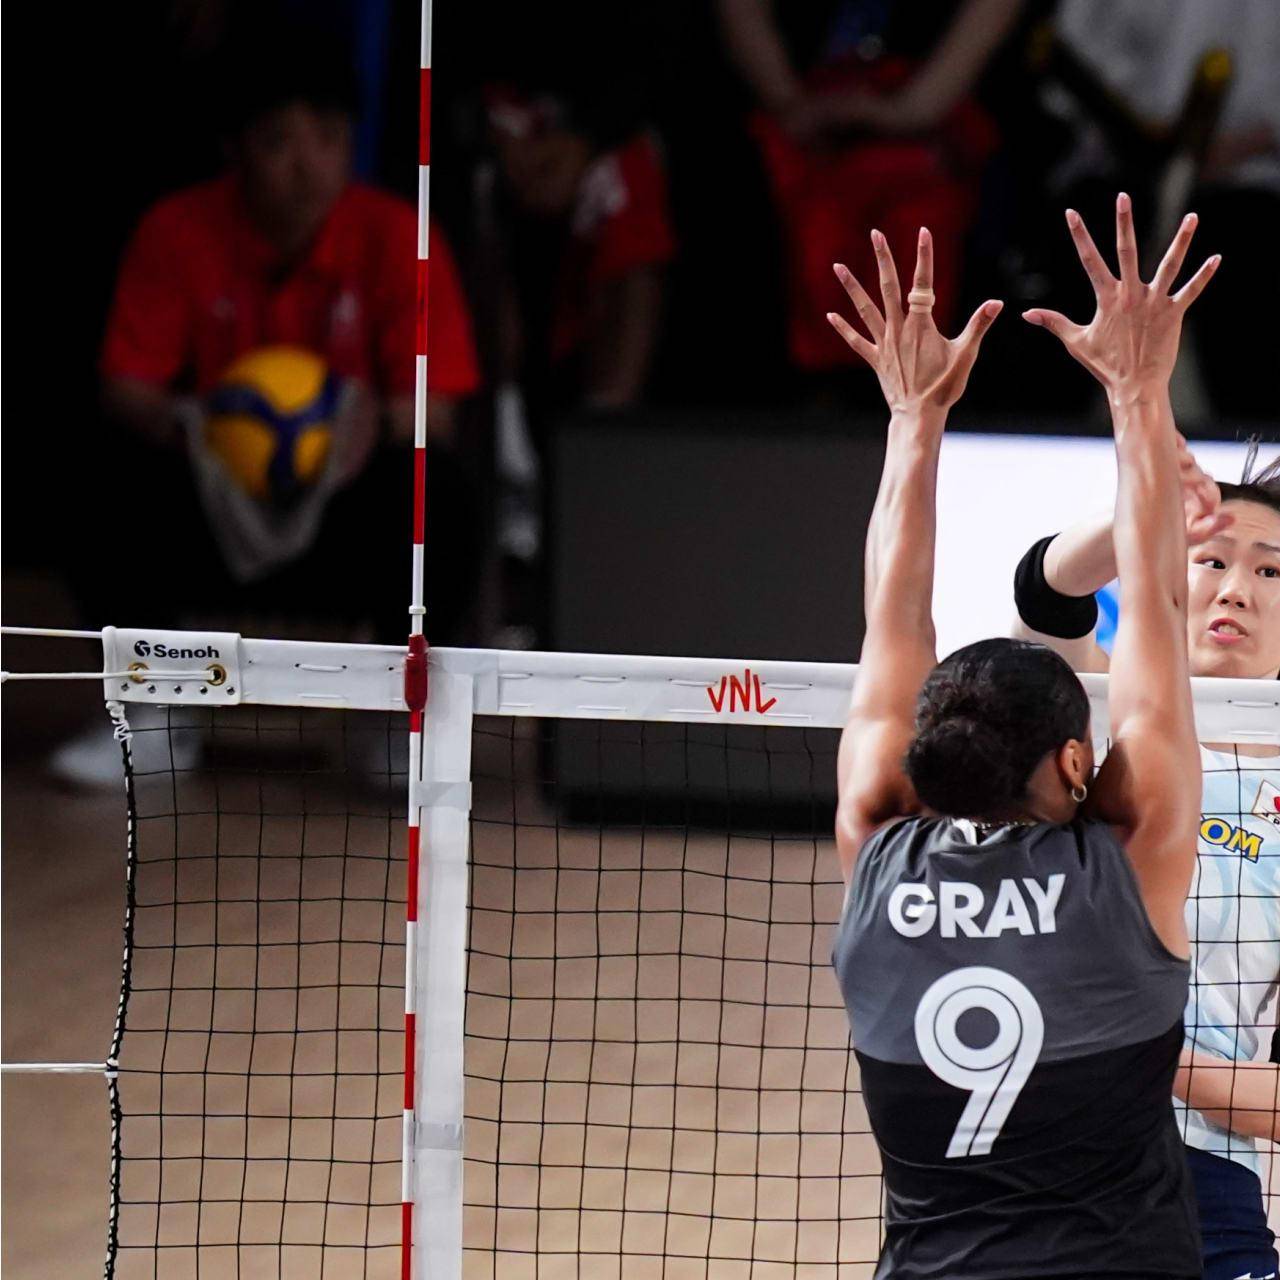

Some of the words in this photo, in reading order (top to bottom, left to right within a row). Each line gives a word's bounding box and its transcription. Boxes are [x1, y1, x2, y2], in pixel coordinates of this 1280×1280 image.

[154, 644, 219, 658] Senoh
[707, 669, 777, 714] VNL
[888, 873, 1066, 938] GRAY
[914, 966, 1045, 1158] 9
